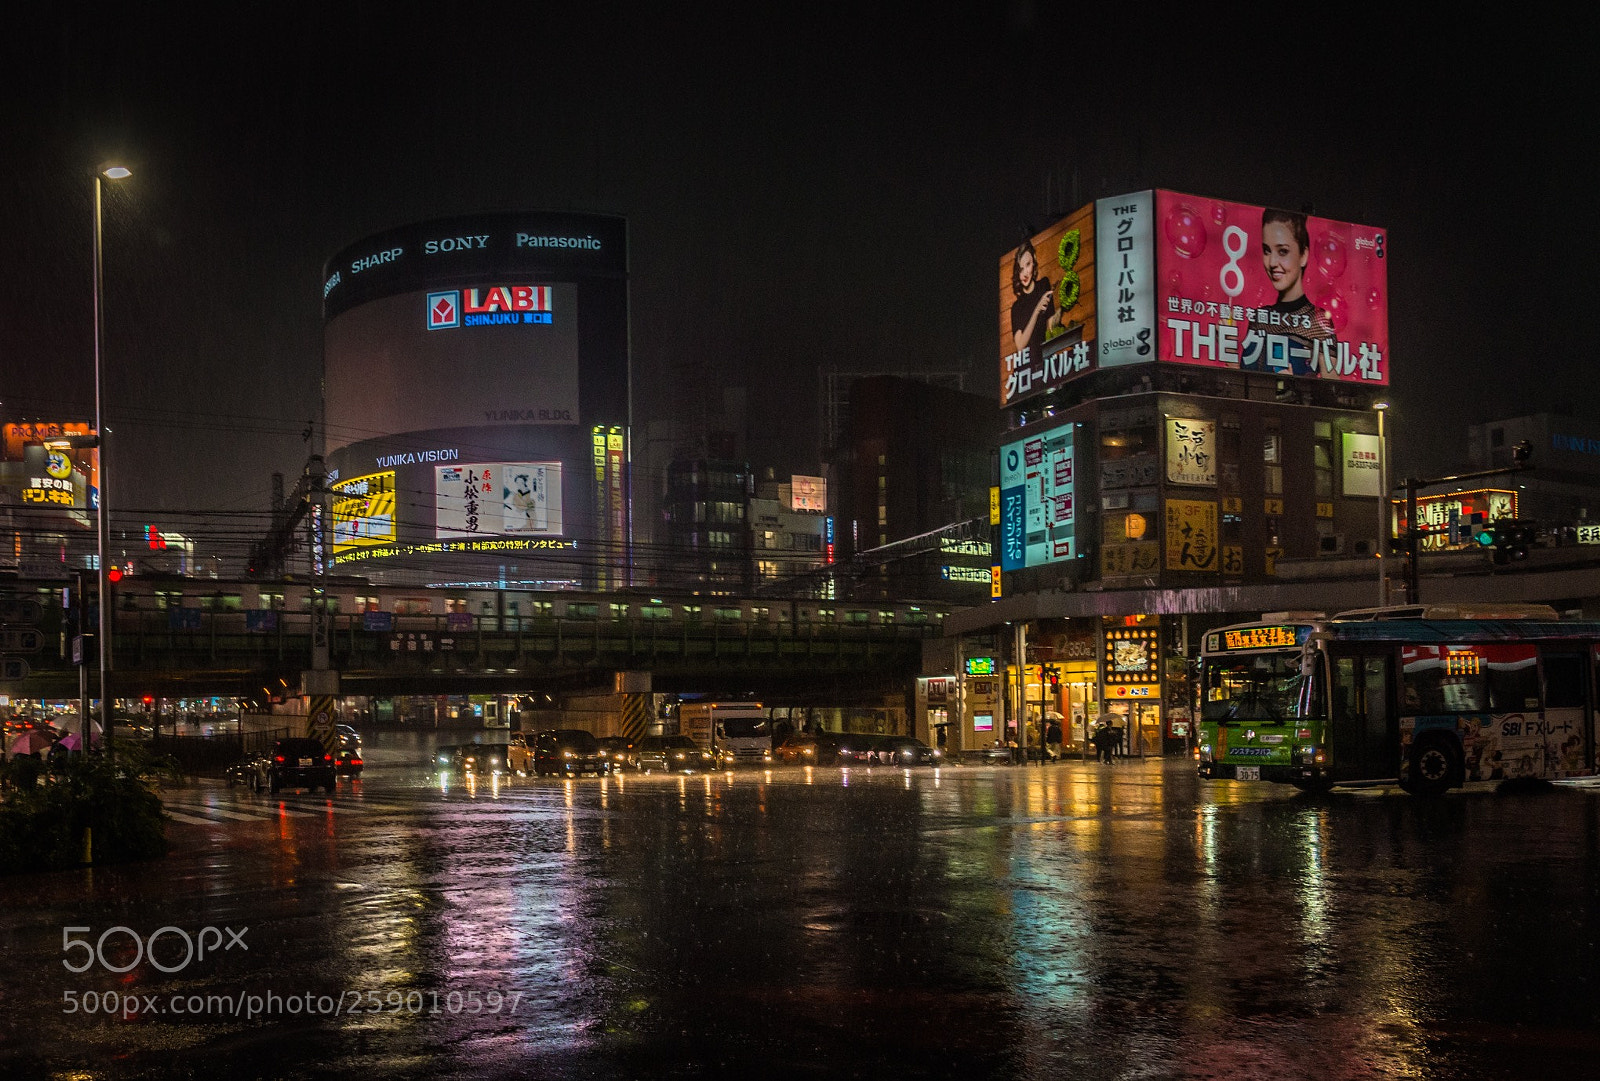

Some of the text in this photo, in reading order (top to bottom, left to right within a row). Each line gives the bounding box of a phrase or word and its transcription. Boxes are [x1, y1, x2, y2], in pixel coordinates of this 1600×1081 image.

[1113, 204, 1138, 215] THE
[424, 235, 490, 255] SONY
[516, 233, 602, 250] Panasonic
[351, 247, 404, 275] SHARP
[1117, 218, 1135, 322] グローバル社
[464, 286, 552, 313] LABI
[465, 313, 519, 326] SHINJUKU
[1167, 297, 1311, 329] 世界の不動産を面白くする
[1102, 335, 1136, 355] global
[1005, 346, 1031, 369] THE
[1005, 341, 1090, 400] グローバル社
[484, 410, 535, 422] YUNIKA
[376, 448, 459, 468] YUNIKA VISION
[464, 469, 479, 533] 小松重男
[1185, 505, 1201, 516] 3F
[929, 681, 945, 694] ATM
[1502, 722, 1521, 735] SBI
[1240, 770, 1259, 780] 30-75
